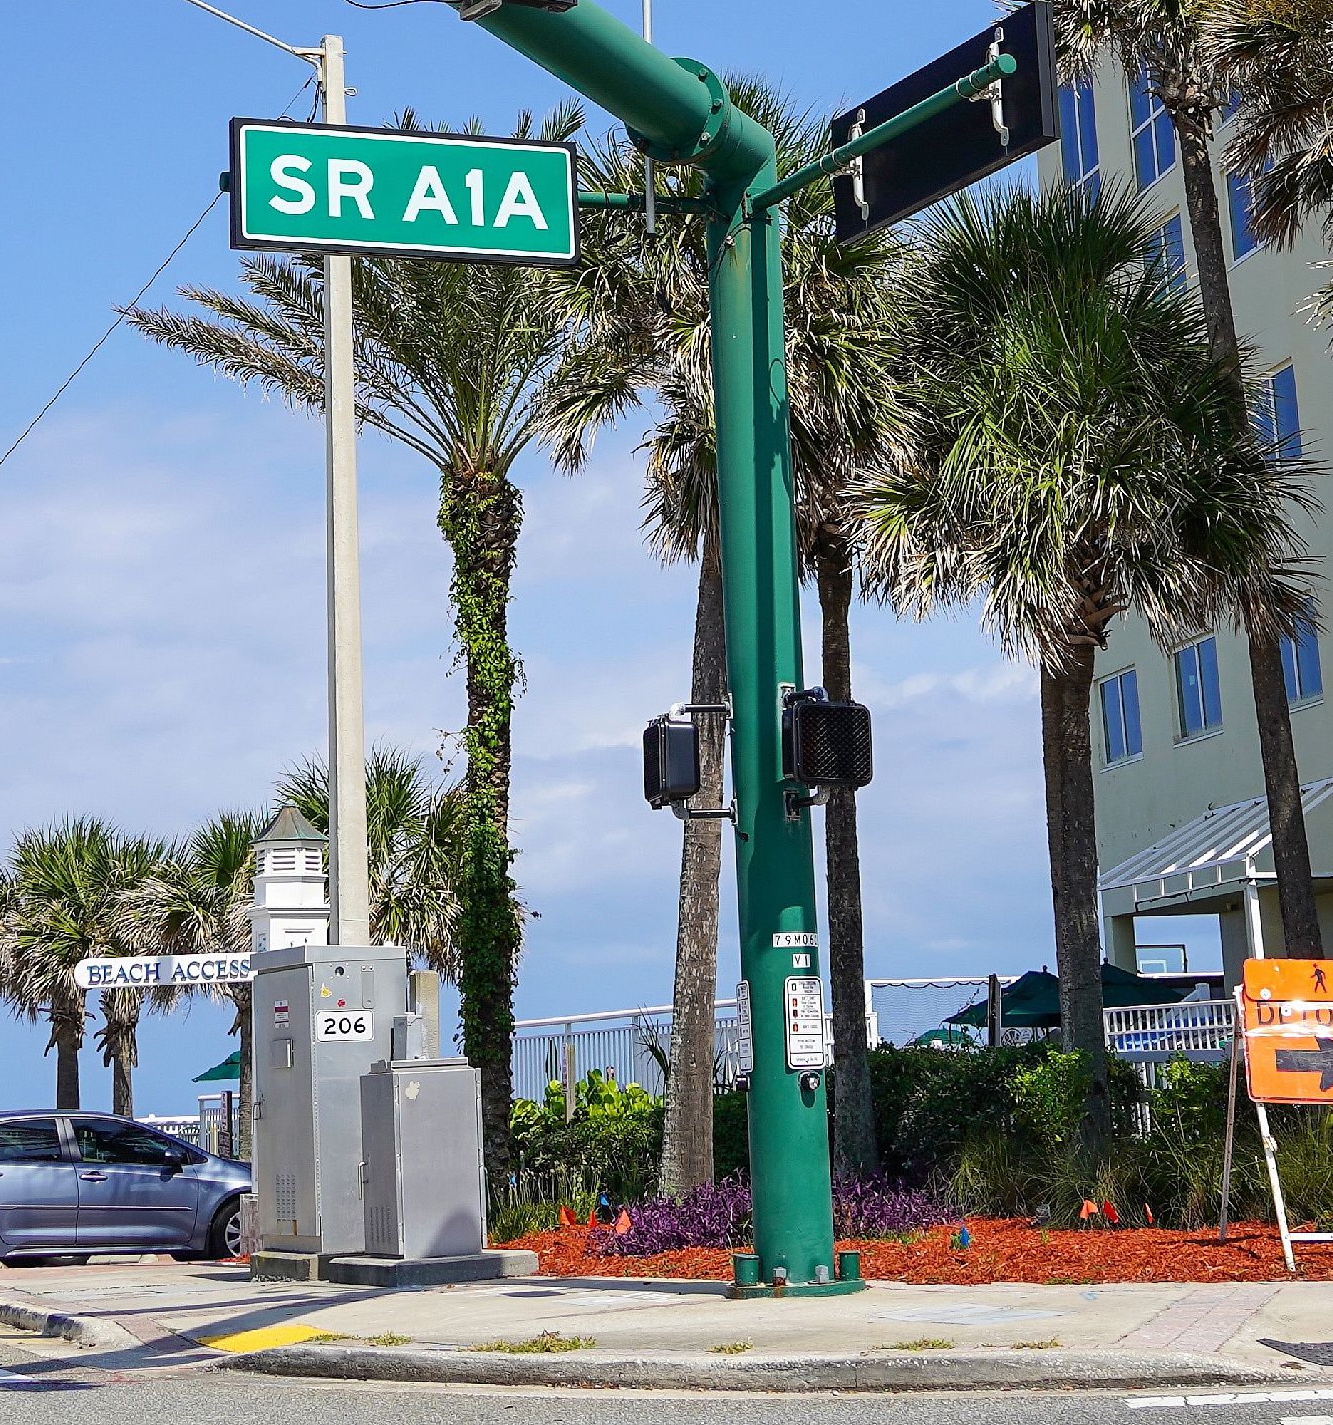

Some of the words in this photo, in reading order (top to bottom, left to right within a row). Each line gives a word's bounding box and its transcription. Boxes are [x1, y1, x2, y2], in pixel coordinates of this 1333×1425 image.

[268, 154, 375, 220] SR
[402, 165, 549, 230] A1A
[86, 962, 161, 985] BEACH
[171, 959, 251, 982] ACCESS
[324, 1017, 366, 1035] 206
